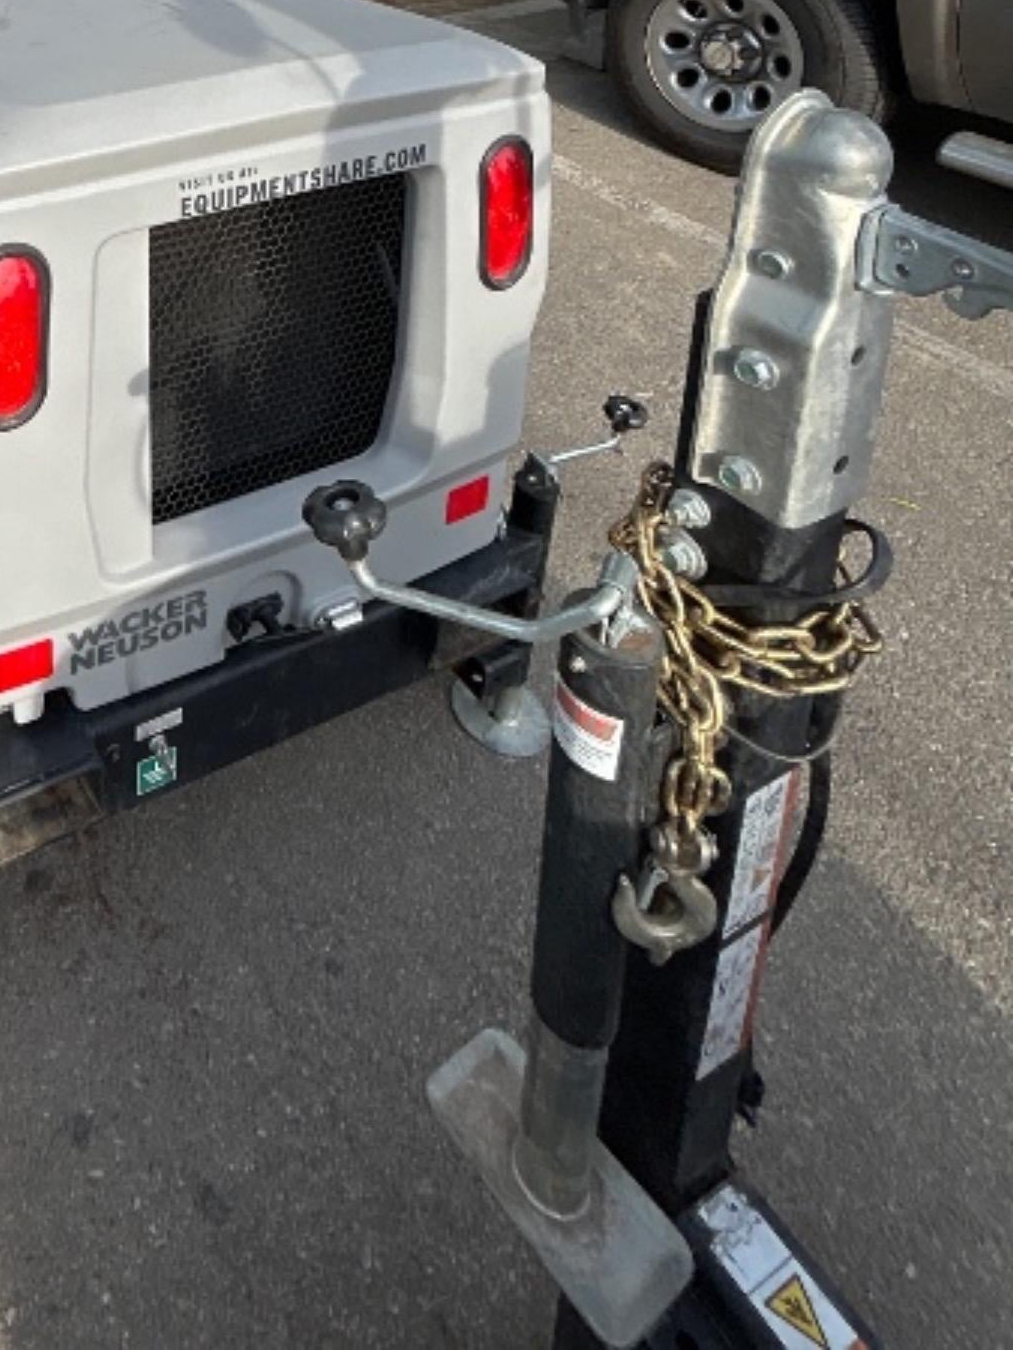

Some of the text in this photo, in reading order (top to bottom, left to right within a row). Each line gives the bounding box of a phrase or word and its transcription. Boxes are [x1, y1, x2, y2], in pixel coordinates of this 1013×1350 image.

[181, 143, 428, 218] EQUIPMENTSHARE.COM
[68, 590, 207, 651] WACKER
[70, 610, 207, 675] NEUSON
